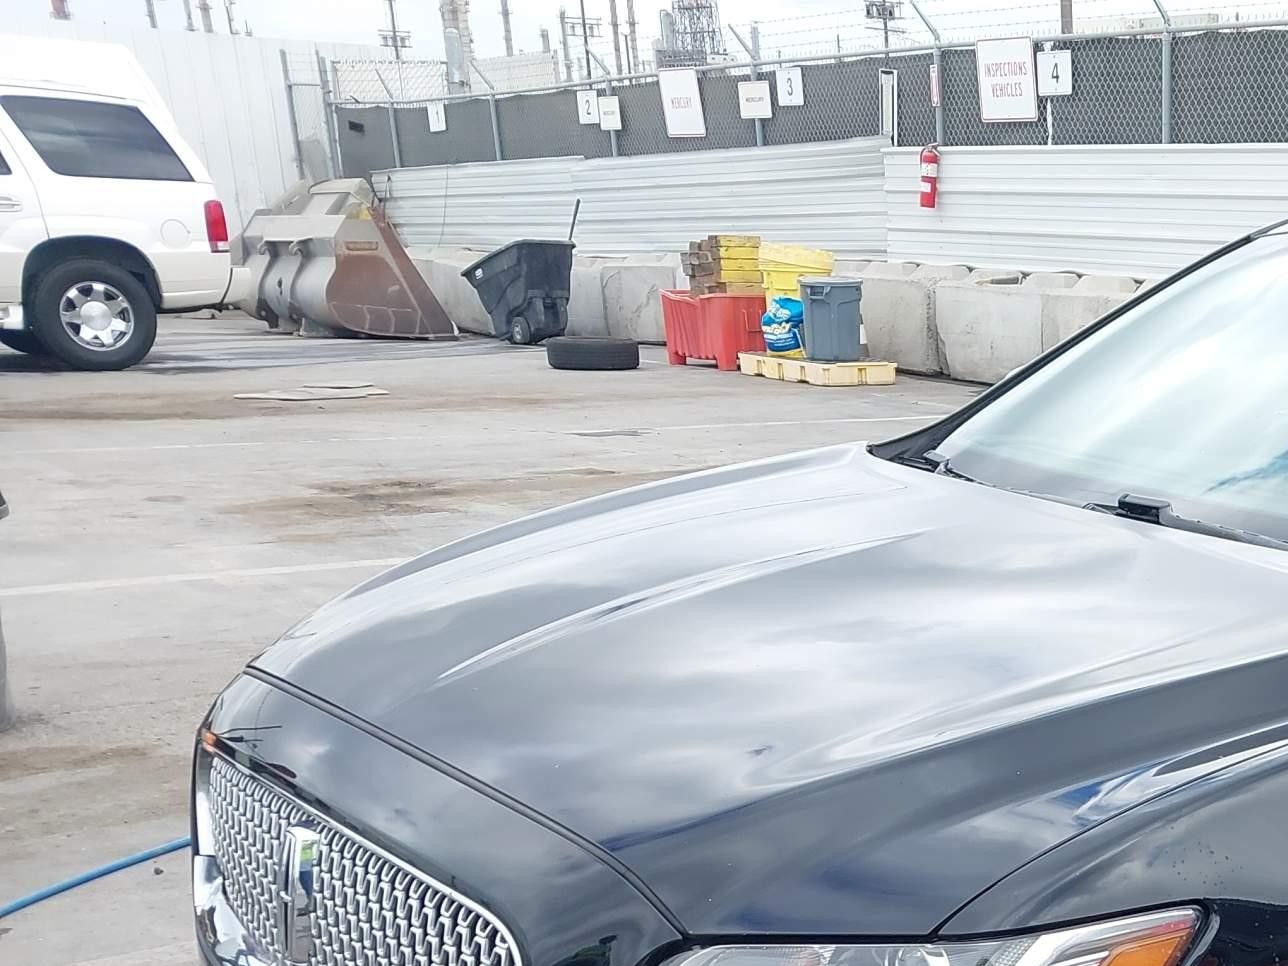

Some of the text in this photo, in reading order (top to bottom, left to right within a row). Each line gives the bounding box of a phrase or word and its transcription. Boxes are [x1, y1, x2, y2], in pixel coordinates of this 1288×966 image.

[984, 60, 1028, 79] INSPECTIONS
[1051, 62, 1060, 85] 4
[786, 77, 794, 97] 3
[991, 81, 1024, 98] VEHICLES
[584, 99, 592, 116] 2
